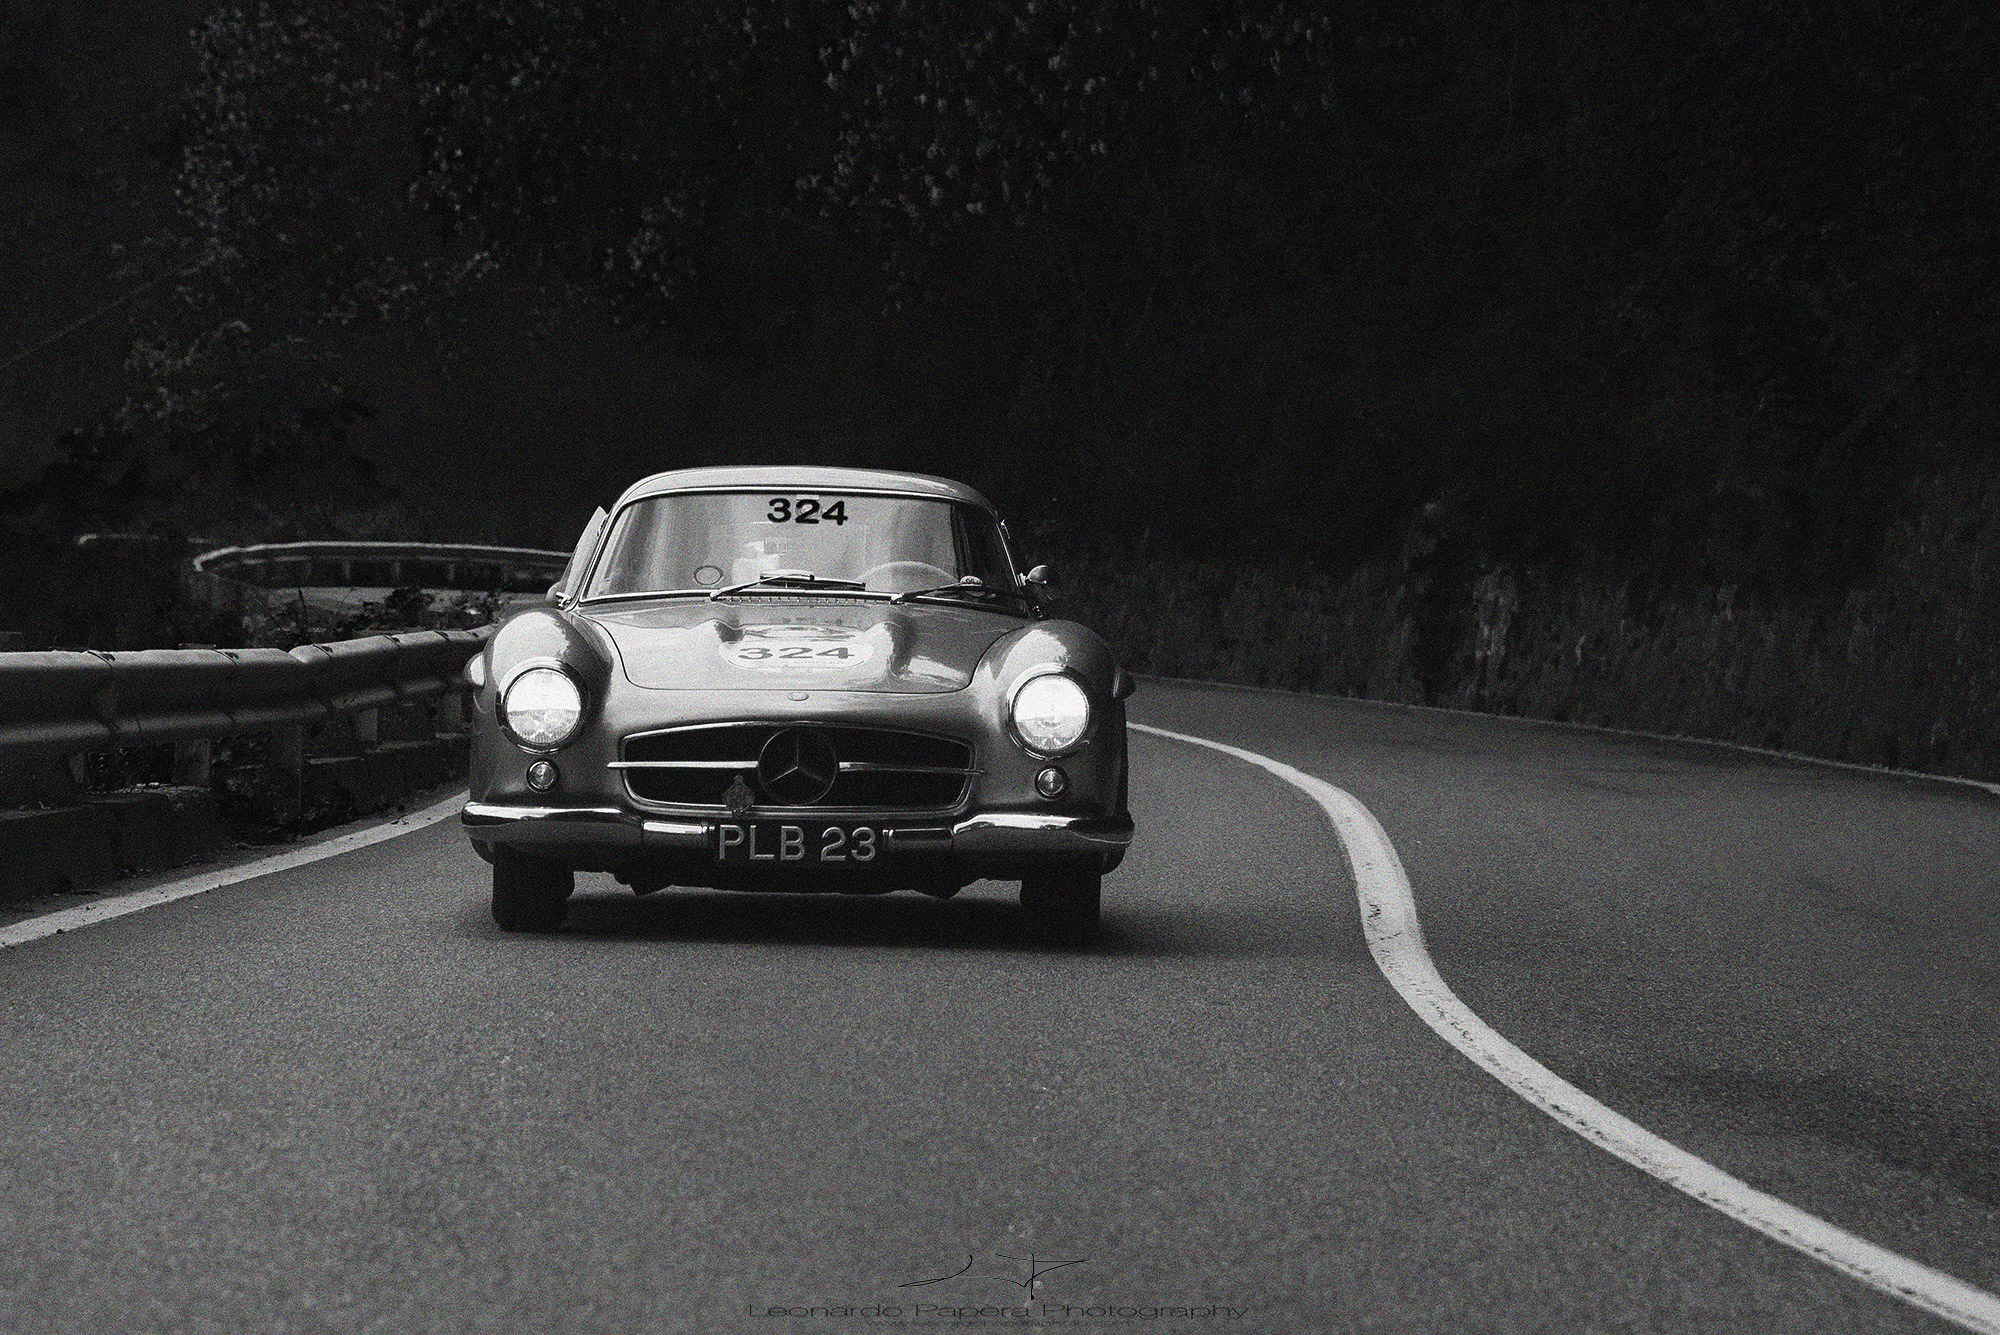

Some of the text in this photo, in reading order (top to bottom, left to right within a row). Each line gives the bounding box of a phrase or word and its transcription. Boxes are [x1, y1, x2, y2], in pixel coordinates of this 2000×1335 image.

[767, 498, 848, 526] 324
[738, 647, 855, 659] 324
[719, 824, 876, 861] PLB 23
